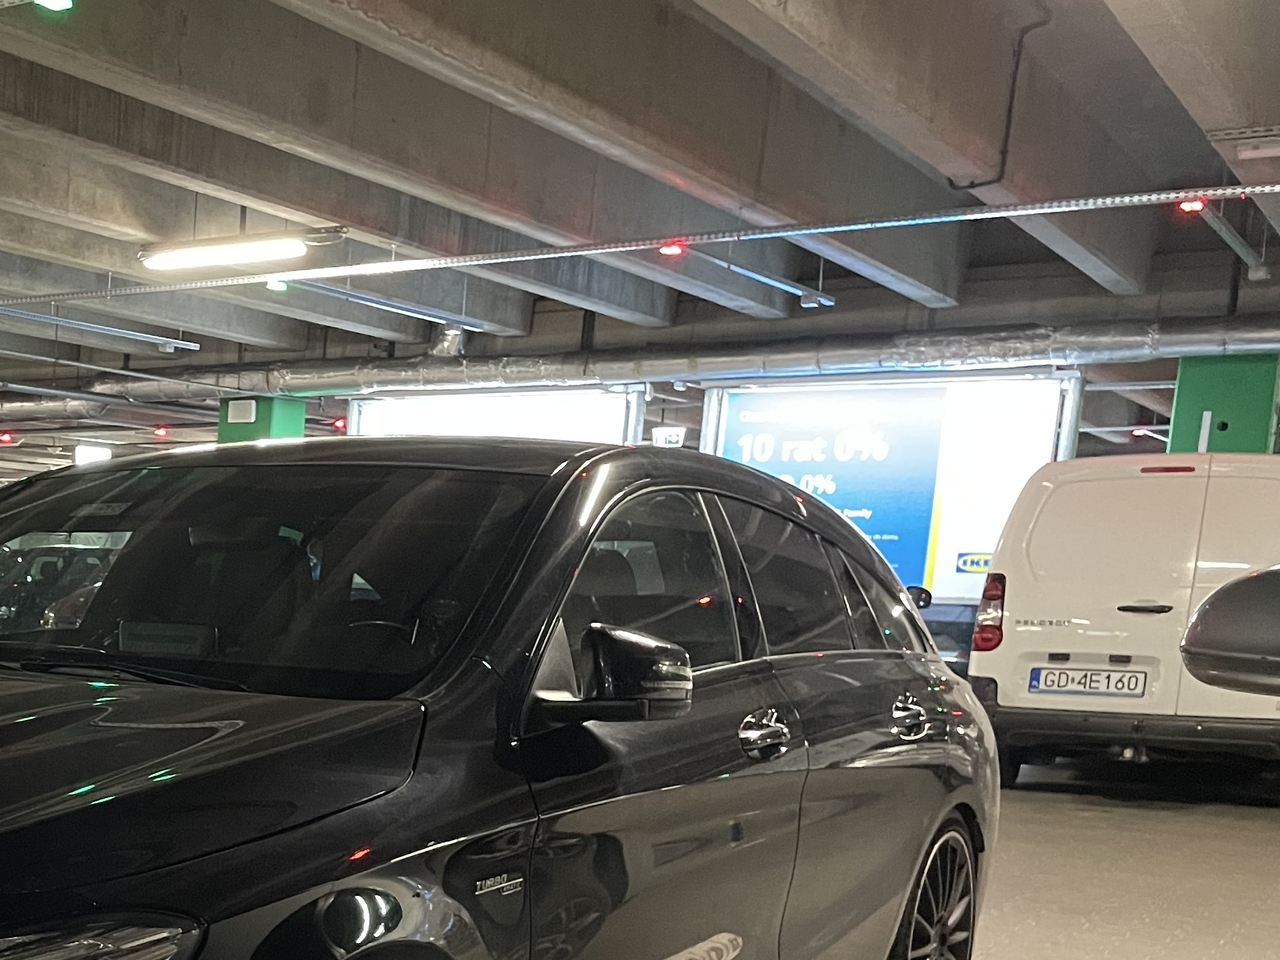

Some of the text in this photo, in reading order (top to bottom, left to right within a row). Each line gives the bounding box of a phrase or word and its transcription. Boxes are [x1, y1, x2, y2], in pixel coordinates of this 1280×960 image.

[737, 429, 889, 463] 10 rat 0%
[962, 559, 990, 567] IKE
[1044, 671, 1138, 691] GD 4E160
[476, 873, 508, 892] TURBO
